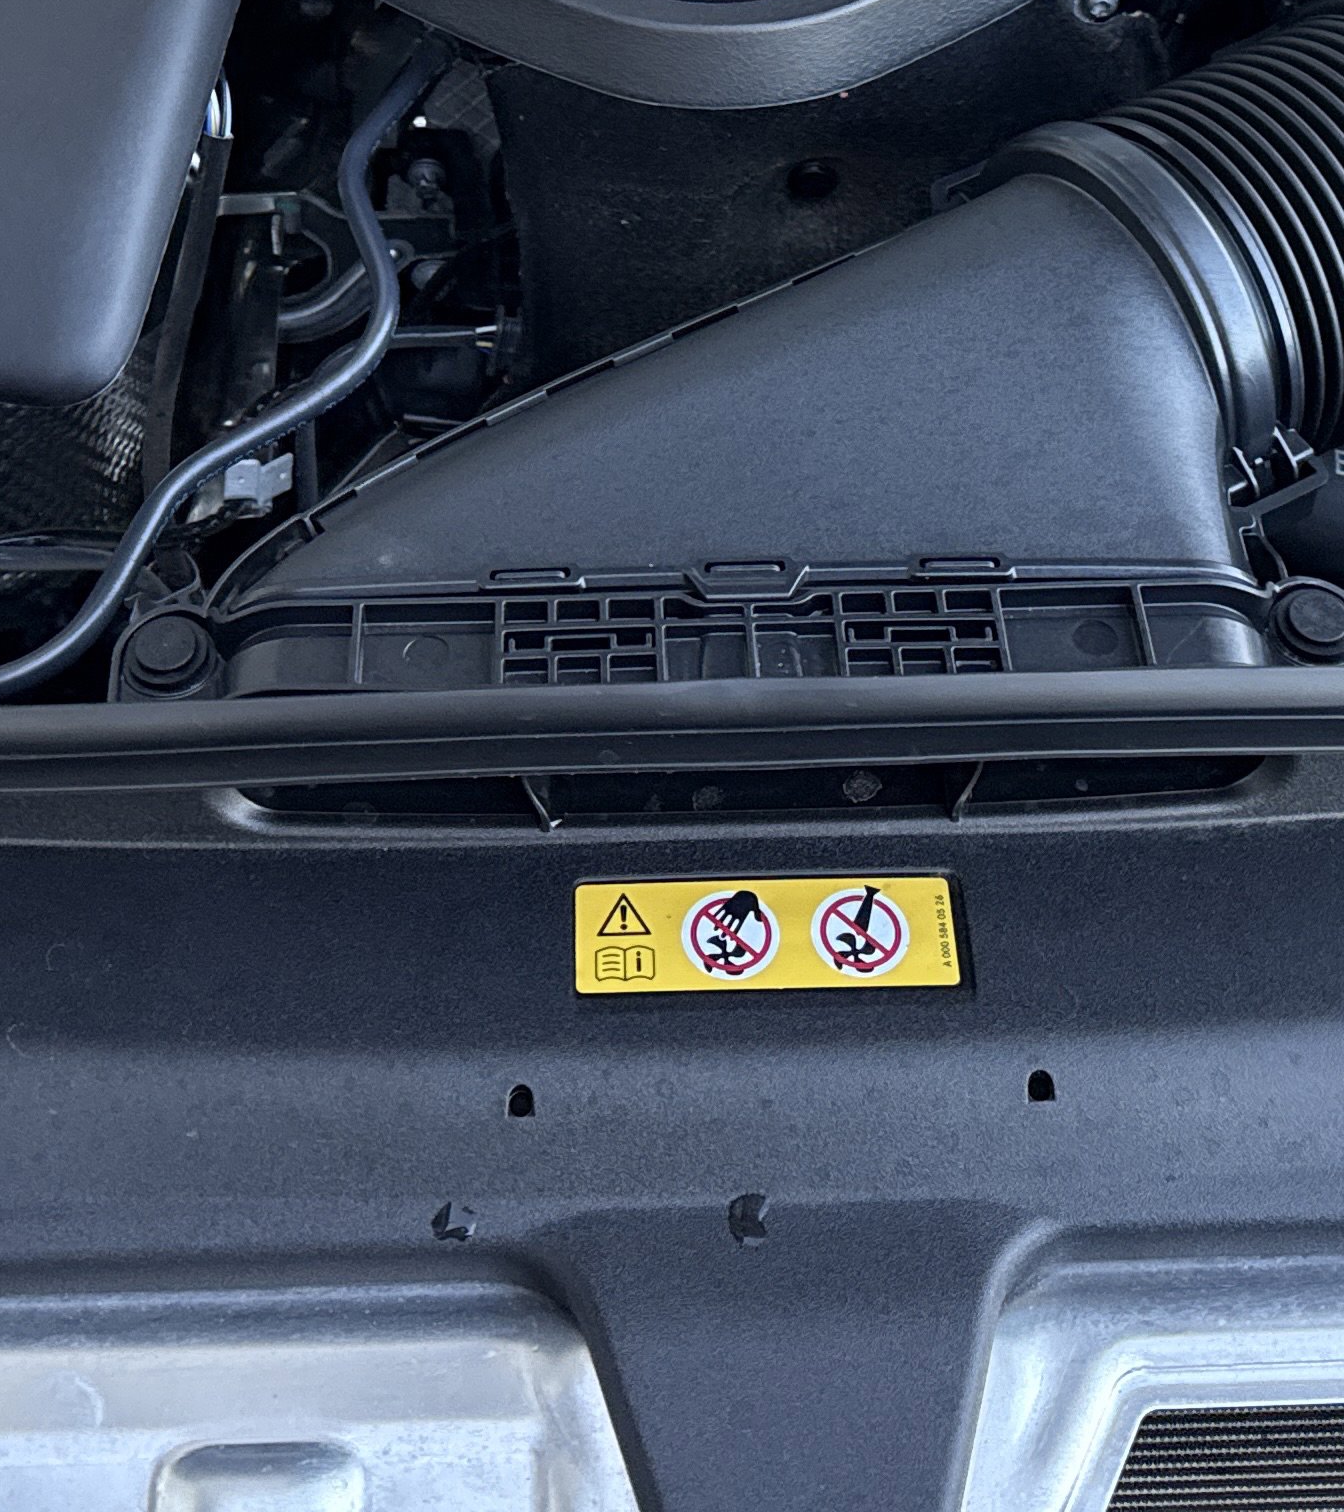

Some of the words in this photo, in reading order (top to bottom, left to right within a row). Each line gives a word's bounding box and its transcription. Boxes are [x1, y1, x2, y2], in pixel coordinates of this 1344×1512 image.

[935, 894, 944, 906] 26
[938, 922, 949, 939] 584
[940, 941, 951, 958] 000
